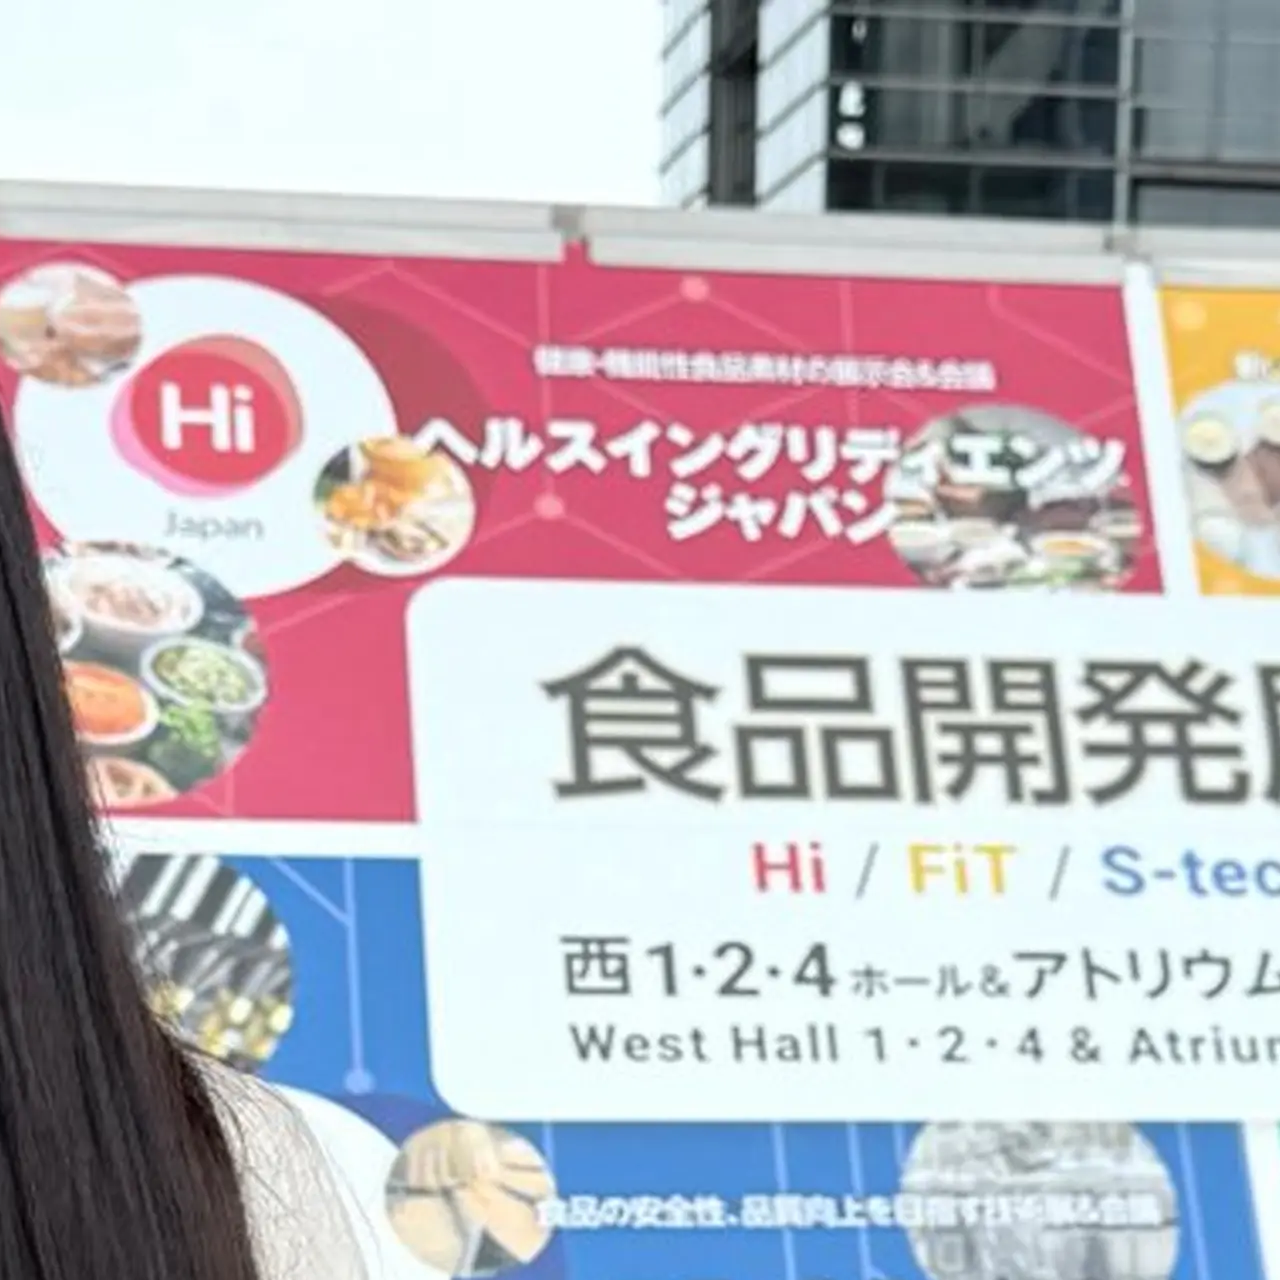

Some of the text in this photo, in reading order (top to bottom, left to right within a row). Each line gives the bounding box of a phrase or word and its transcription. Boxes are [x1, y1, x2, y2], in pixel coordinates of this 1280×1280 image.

[158, 383, 255, 453] Hi
[162, 509, 265, 542] Japan
[663, 483, 895, 543] ジャパン
[751, 842, 827, 893] Hi
[907, 843, 1017, 894] FiT
[570, 1025, 707, 1063] West
[733, 1024, 838, 1063] Hall
[1070, 1027, 1102, 1063] &
